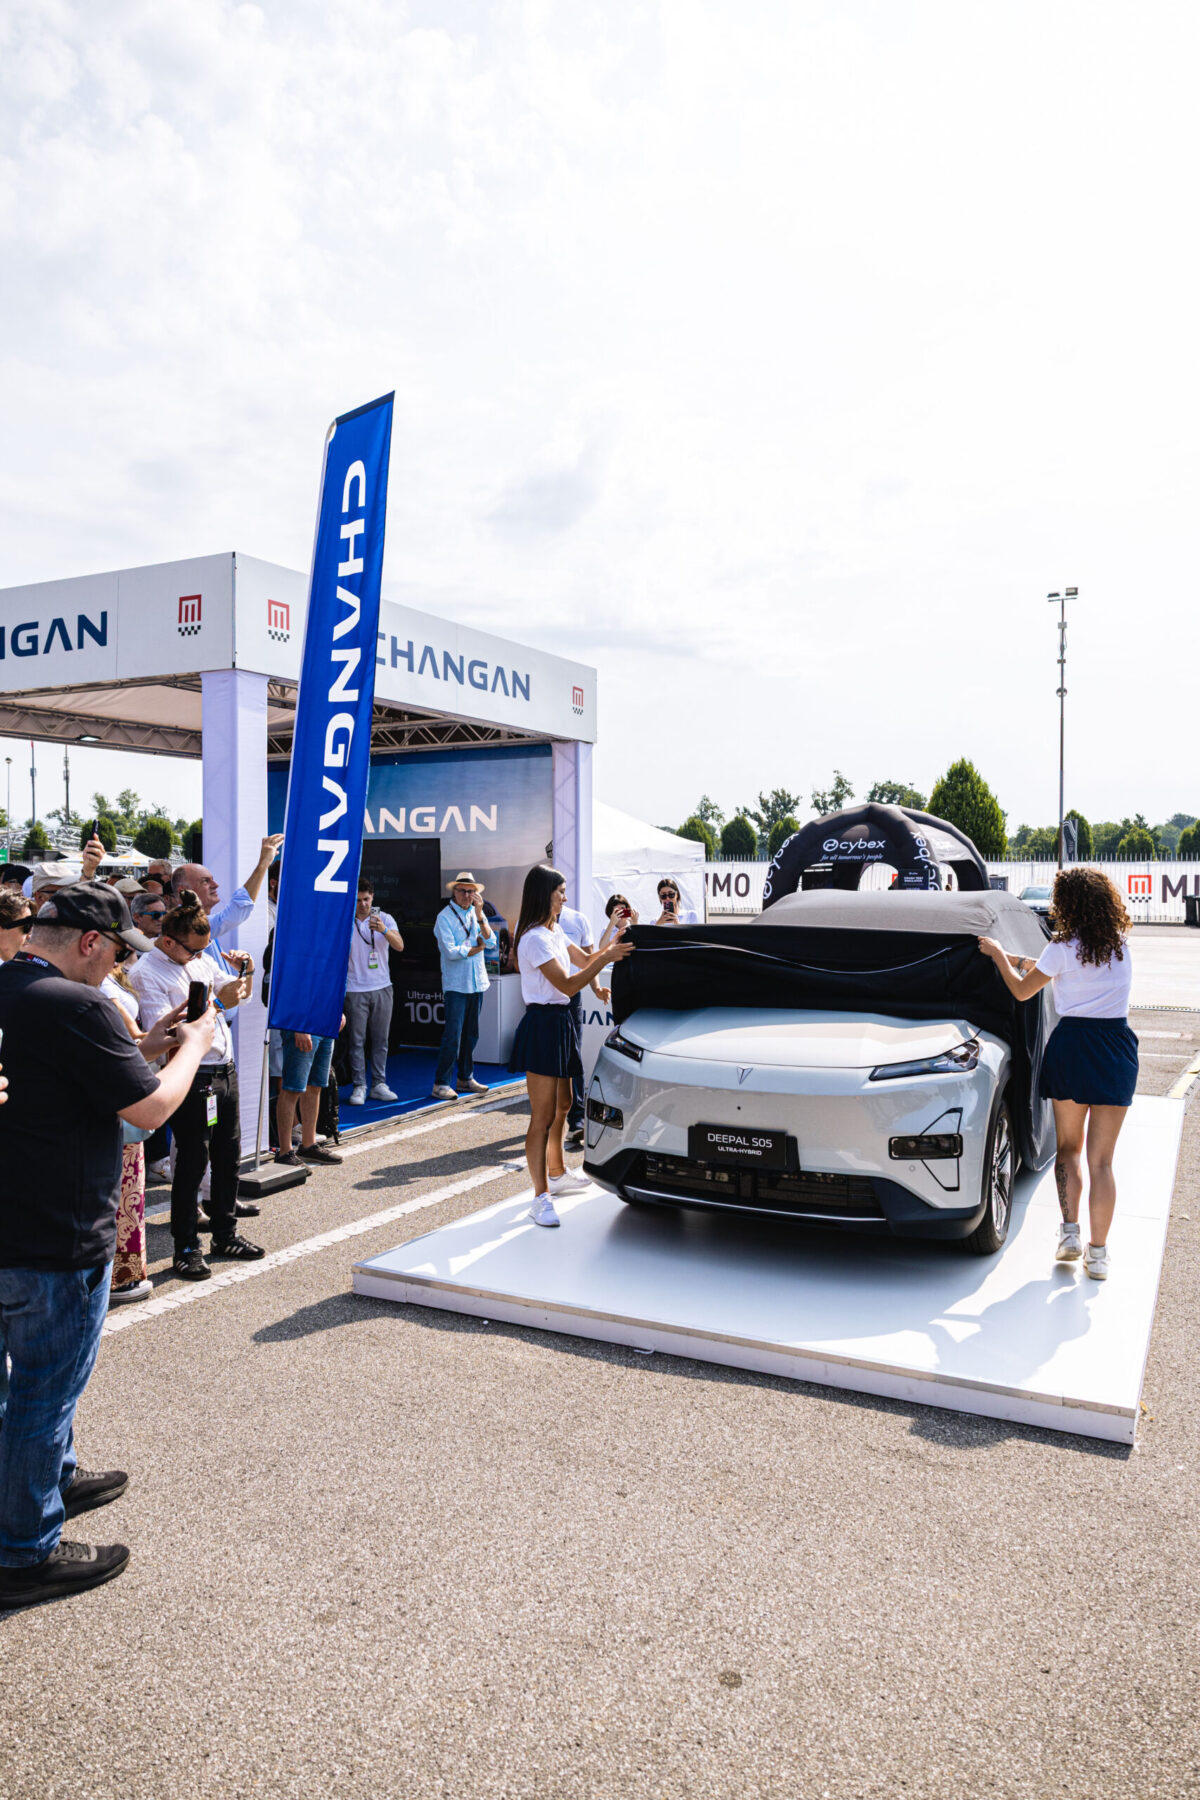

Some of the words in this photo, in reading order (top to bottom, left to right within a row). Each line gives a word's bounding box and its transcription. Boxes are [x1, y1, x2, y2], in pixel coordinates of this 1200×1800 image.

[0, 611, 107, 660] GAN
[314, 459, 366, 893] CHANGAN
[839, 838, 886, 854] cybex
[707, 1133, 749, 1145] DEEPAL
[718, 1146, 762, 1155] ULTRA-HYBRID
